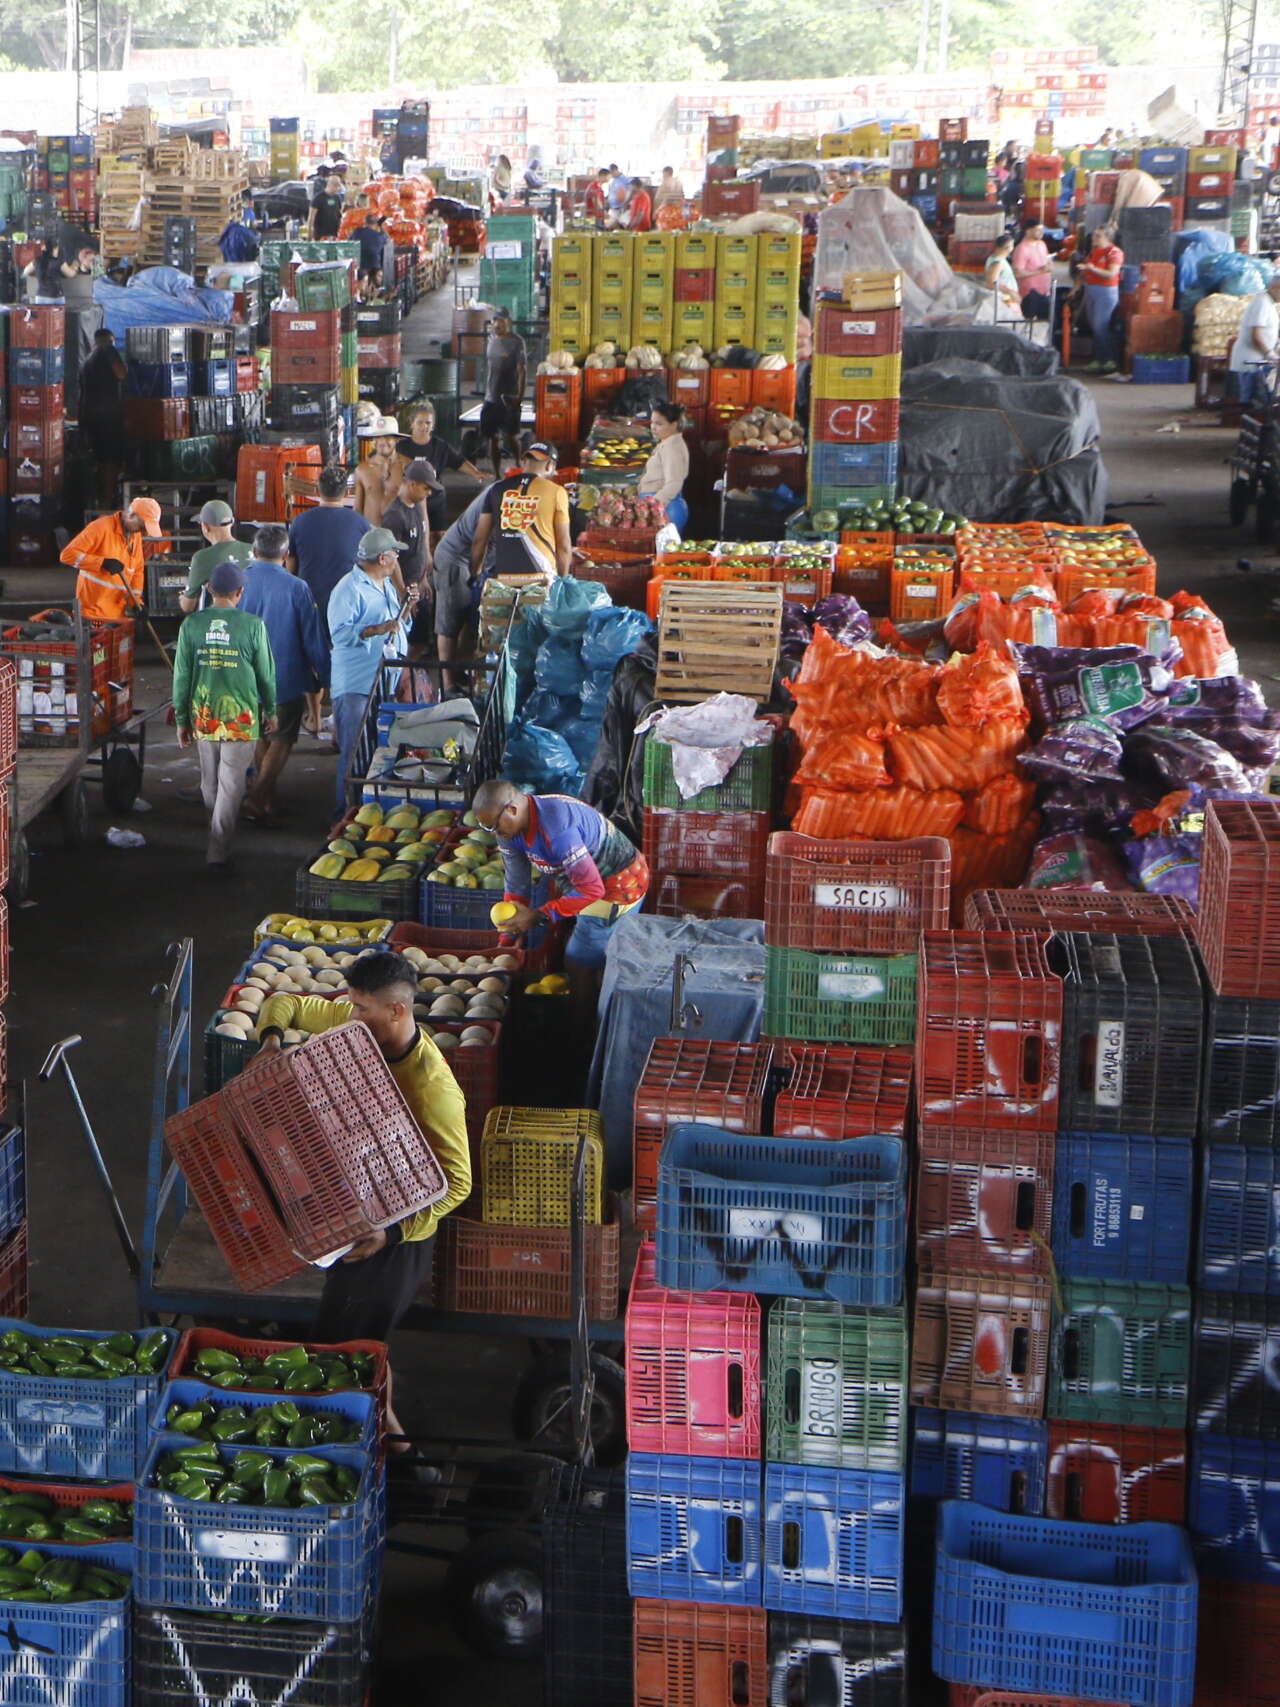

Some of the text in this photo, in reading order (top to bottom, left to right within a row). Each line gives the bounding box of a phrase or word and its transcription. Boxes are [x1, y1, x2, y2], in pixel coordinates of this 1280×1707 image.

[829, 405, 877, 440] CR
[832, 886, 888, 907] SACIS
[1093, 1178, 1108, 1247] FORT FRUTAS
[807, 1357, 837, 1436] GRINGO
